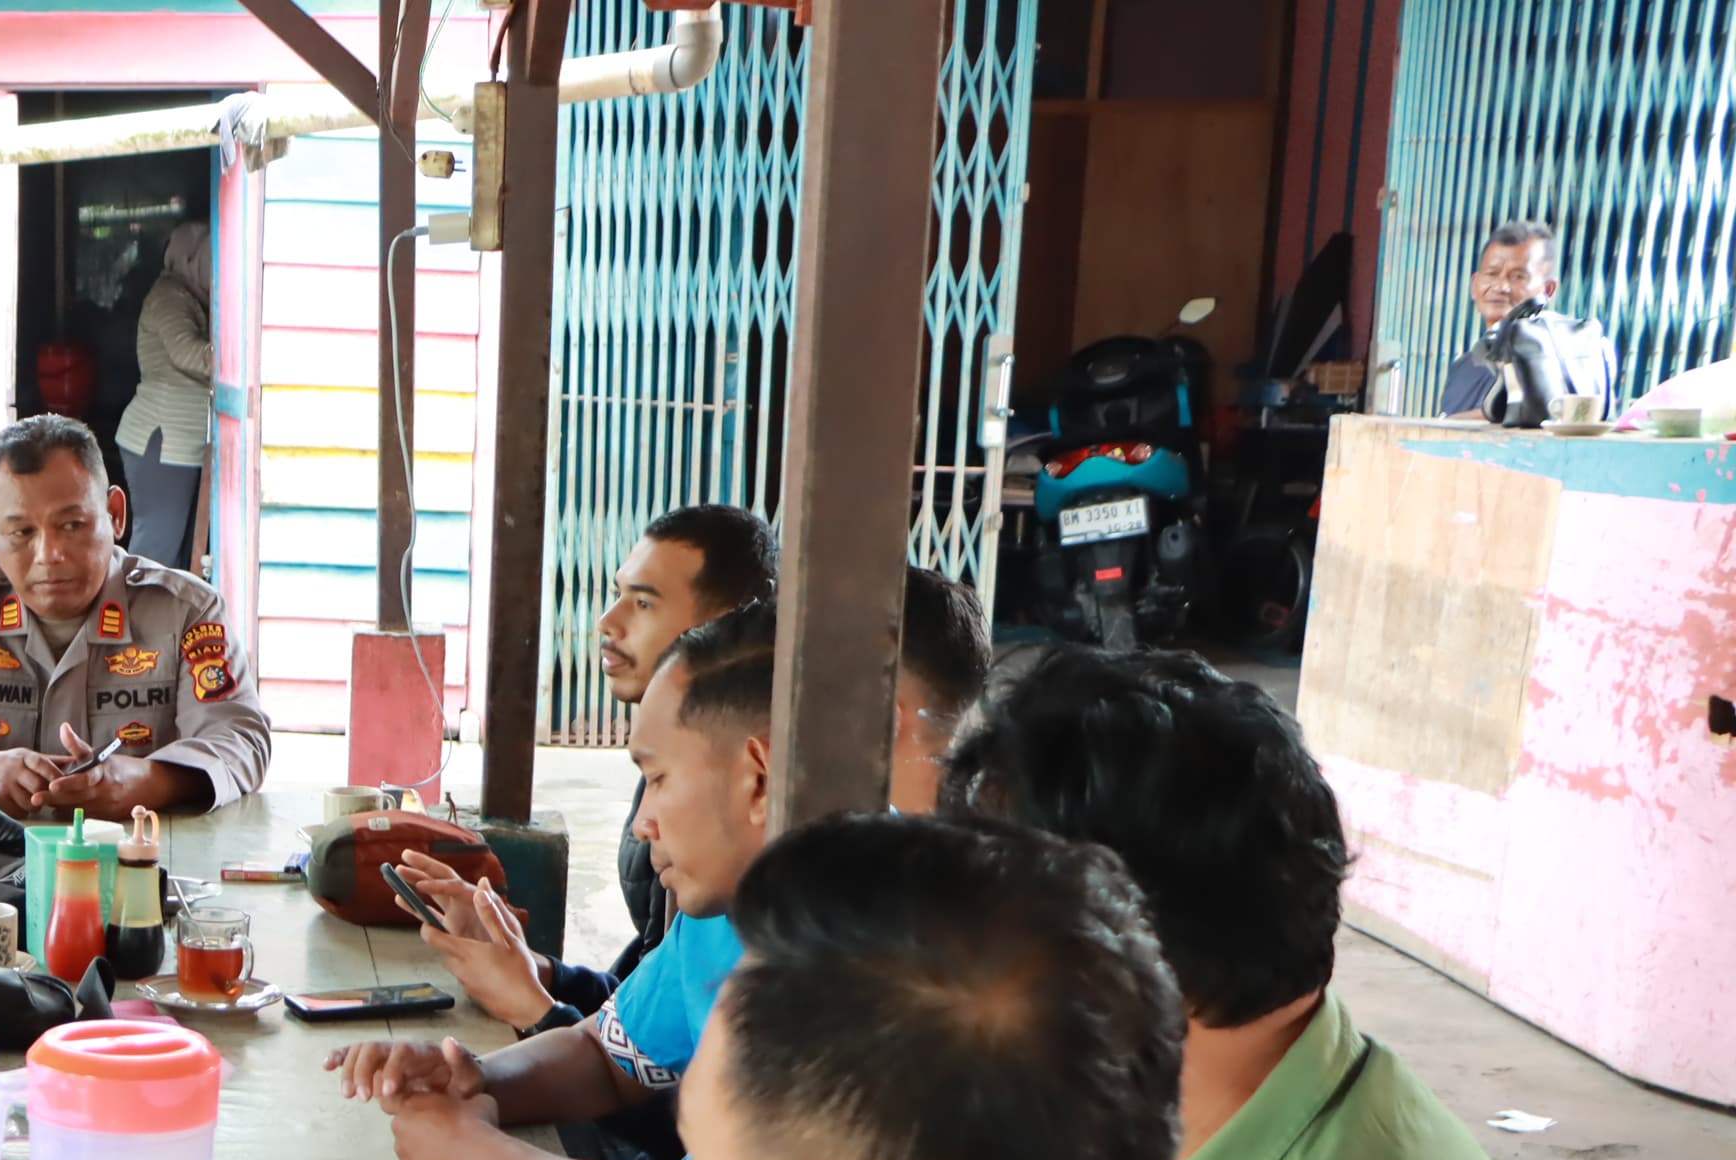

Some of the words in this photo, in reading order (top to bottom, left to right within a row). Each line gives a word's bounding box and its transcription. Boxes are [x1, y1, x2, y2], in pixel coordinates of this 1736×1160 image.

[1063, 511, 1080, 526] BM
[1086, 505, 1118, 522] 3350
[188, 645, 221, 659] RIAU
[97, 687, 170, 710] POLRI
